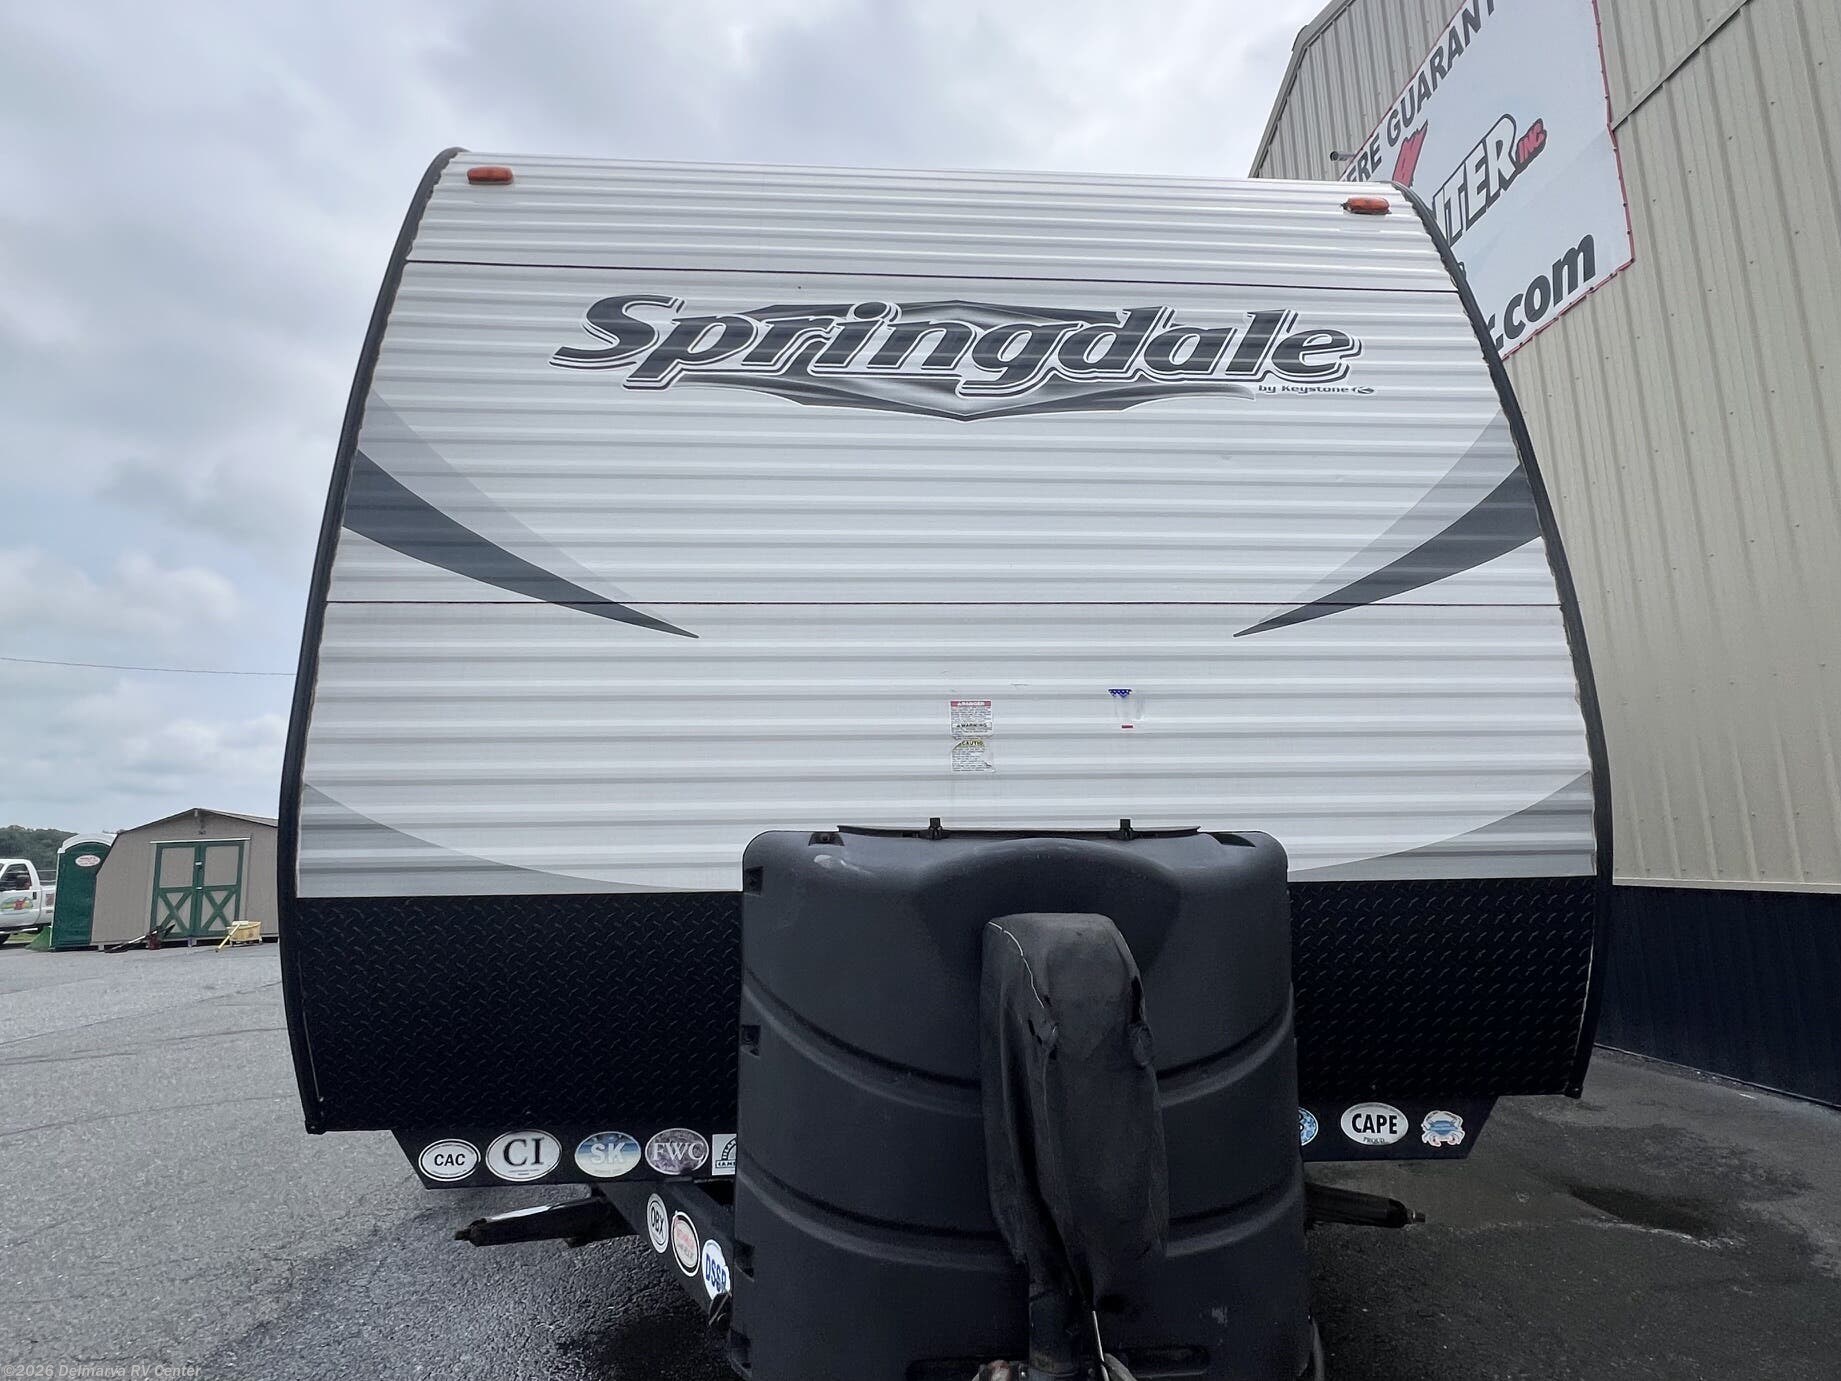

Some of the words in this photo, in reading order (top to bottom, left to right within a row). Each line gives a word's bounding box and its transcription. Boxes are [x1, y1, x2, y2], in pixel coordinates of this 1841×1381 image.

[1488, 234, 1596, 351] .com
[549, 294, 1362, 397] Springdale
[1259, 385, 1276, 394] by
[1281, 385, 1349, 394] Keystone
[1352, 1113, 1397, 1135] CAPE
[434, 1153, 466, 1167] CAC
[503, 1137, 545, 1167] CI
[590, 1143, 626, 1165] SK
[653, 1141, 706, 1161] FWC
[651, 1206, 665, 1239] OBX
